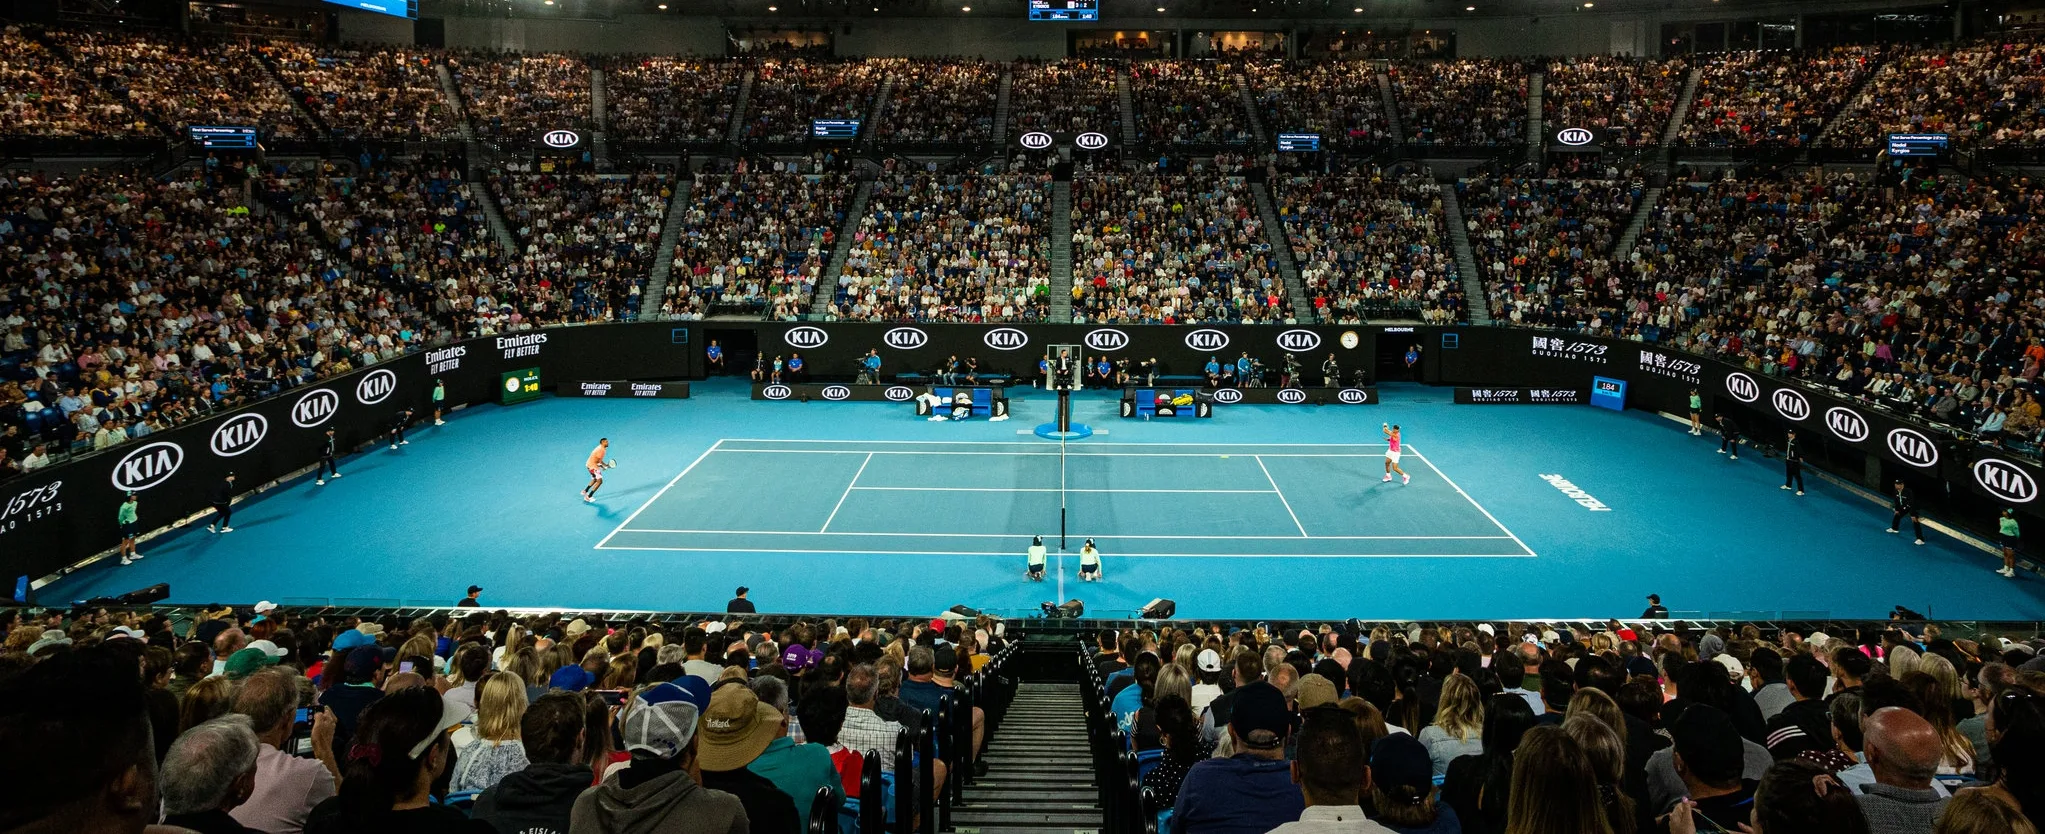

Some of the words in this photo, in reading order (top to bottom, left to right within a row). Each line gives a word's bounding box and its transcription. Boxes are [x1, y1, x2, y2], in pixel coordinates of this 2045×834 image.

[550, 134, 573, 144] KIA
[1026, 136, 1046, 145] KIA
[1082, 136, 1102, 145] KIA
[1564, 132, 1586, 141] KIA
[496, 333, 547, 349] Emirates
[792, 331, 821, 344] KIA
[892, 332, 920, 344] KIA
[992, 333, 1021, 345] KIA
[1092, 333, 1122, 346] KIA
[1193, 334, 1222, 346] KIA
[1284, 334, 1313, 347] KIA
[425, 345, 466, 365] Emirates
[504, 348, 515, 359] FLY
[516, 345, 540, 357] BETTER
[1566, 342, 1608, 355] 1573
[1532, 350, 1576, 359] GUOJIAO
[1584, 356, 1606, 364] 1573
[431, 363, 439, 375] FLY
[439, 358, 459, 372] BETTER
[1668, 359, 1701, 374] 1573
[1640, 364, 1676, 378] GUOJIAO
[1682, 374, 1700, 384] 1573
[363, 375, 390, 399] KIA
[768, 388, 786, 396] KIA
[827, 389, 845, 397] KIA
[890, 389, 908, 398] KIA
[1732, 376, 1753, 398] KIA
[1219, 392, 1238, 400] KIA
[1282, 392, 1301, 400] KIA
[1343, 392, 1362, 400] KIA
[300, 395, 332, 422] KIA
[1779, 393, 1803, 416] KIA
[1832, 411, 1861, 437] KIA
[221, 420, 259, 451] KIA
[1896, 433, 1929, 462] KIA
[125, 449, 172, 485] KIA
[1984, 464, 2026, 497] KIA
[0, 480, 62, 520] 1573
[27, 502, 62, 522] 1573
